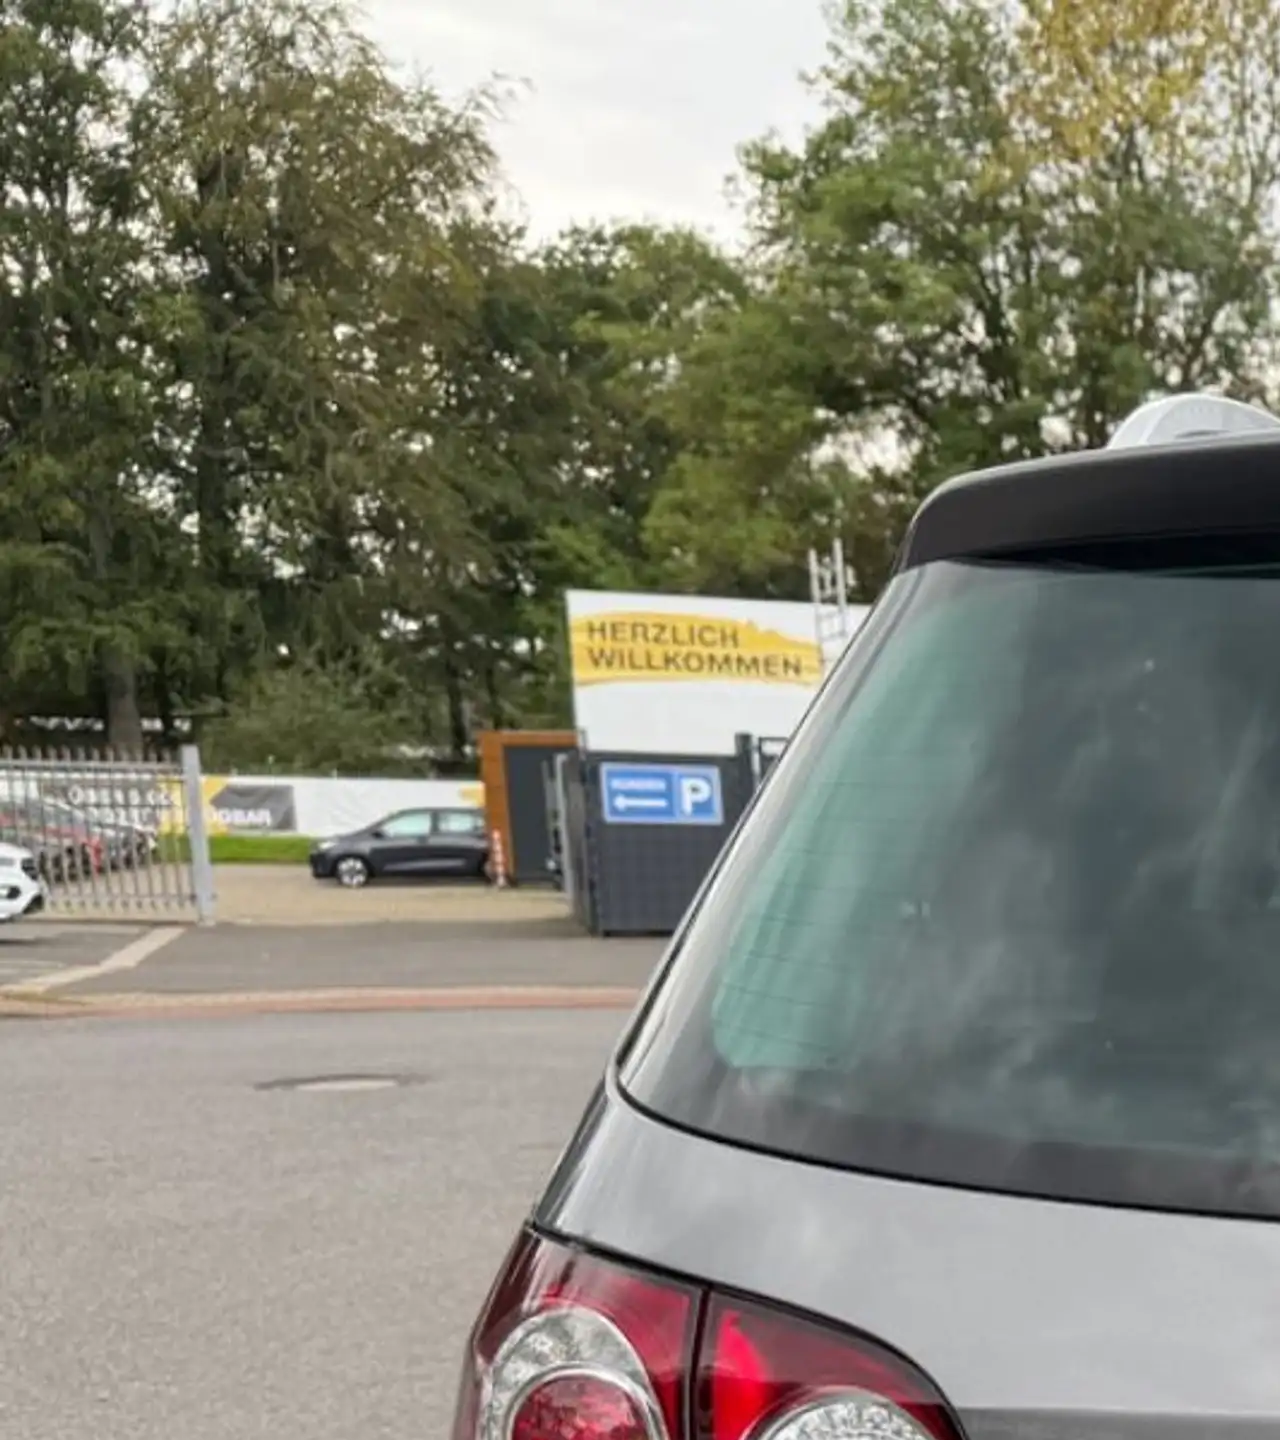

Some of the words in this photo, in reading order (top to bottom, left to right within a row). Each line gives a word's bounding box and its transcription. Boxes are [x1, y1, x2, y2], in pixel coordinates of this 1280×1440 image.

[586, 620, 740, 648] HERZLICH
[586, 647, 802, 676] WILLKOMMEN
[681, 777, 711, 816] P
